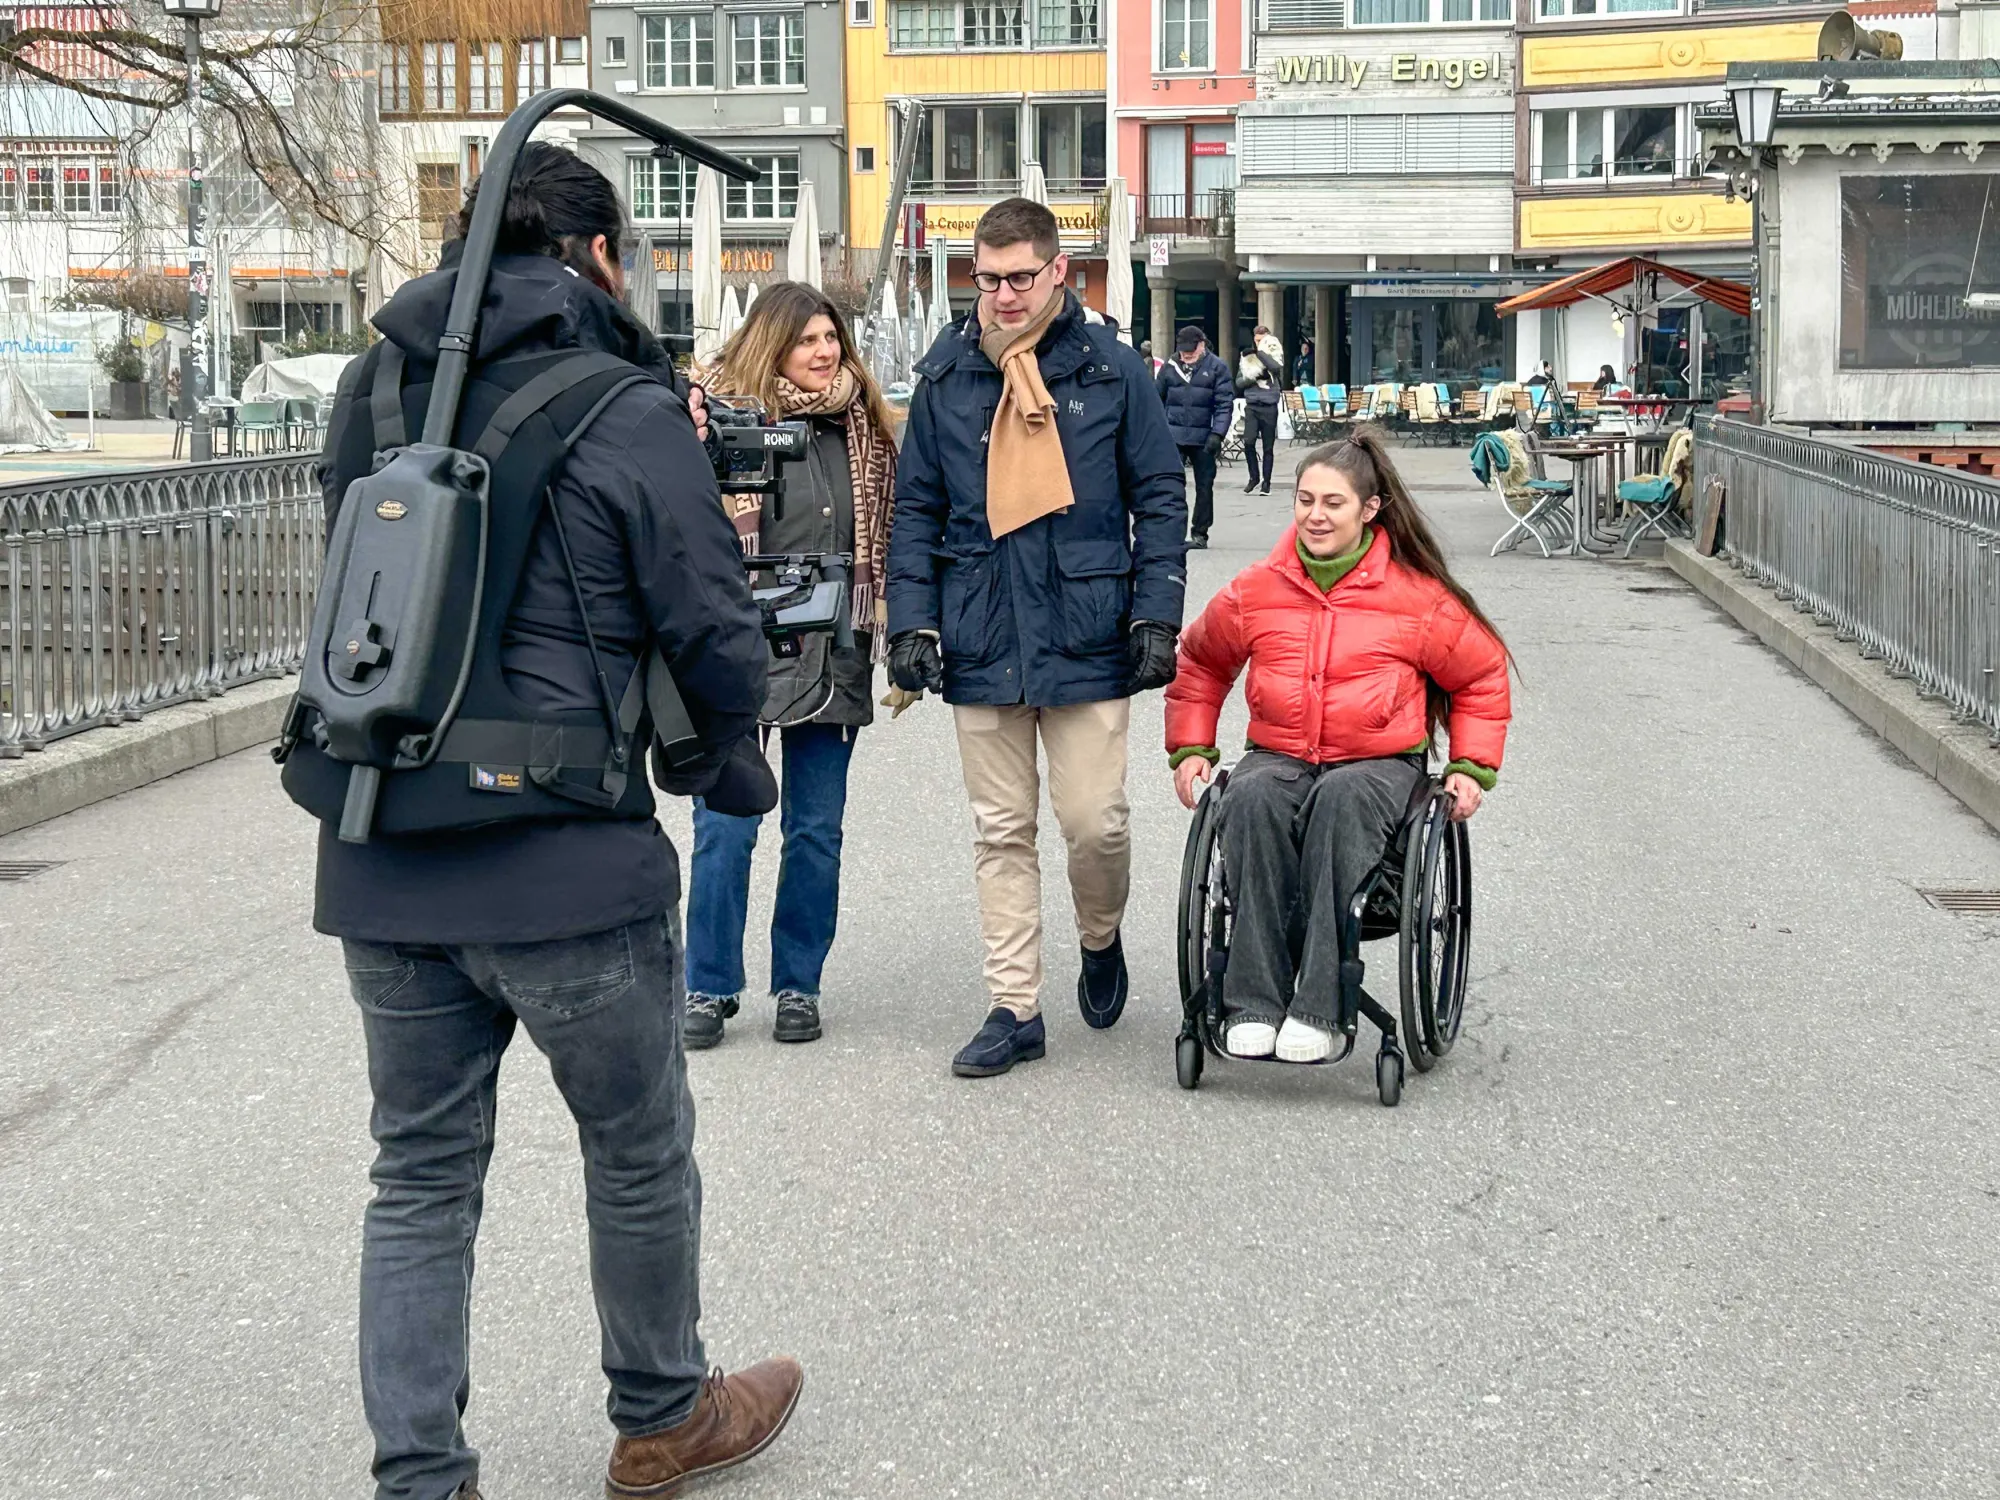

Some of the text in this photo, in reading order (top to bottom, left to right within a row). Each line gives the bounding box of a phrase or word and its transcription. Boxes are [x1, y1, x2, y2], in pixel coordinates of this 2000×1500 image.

[1275, 51, 1501, 90] Willy Engel
[687, 249, 773, 273] MINO
[764, 433, 794, 446] RONIN
